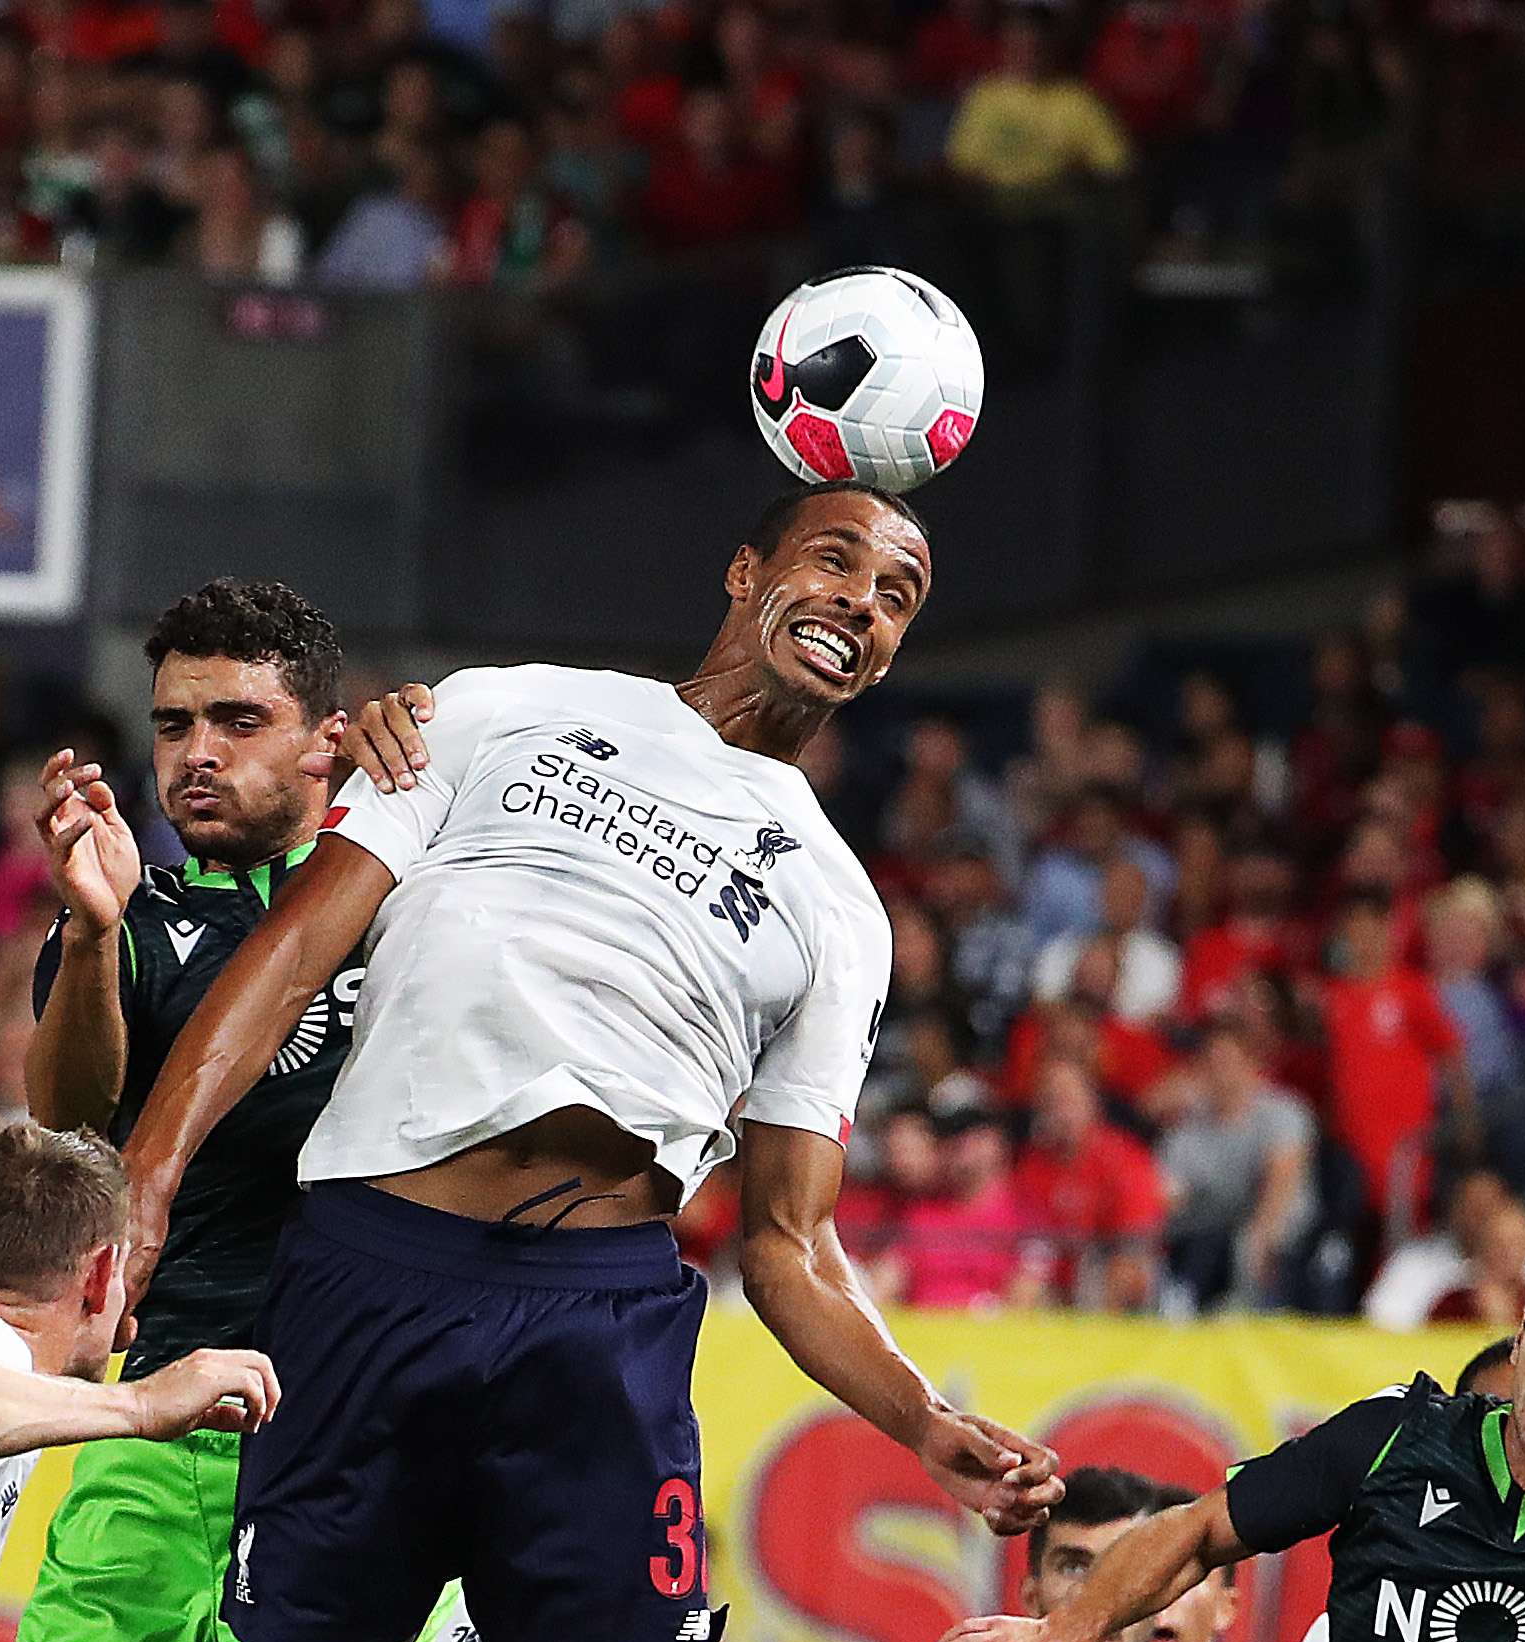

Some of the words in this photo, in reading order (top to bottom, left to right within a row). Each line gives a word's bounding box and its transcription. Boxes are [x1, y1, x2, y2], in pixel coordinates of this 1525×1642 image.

[501, 782, 708, 899] Chartered
[530, 754, 724, 870] Standard
[649, 1477, 709, 1600] 3
